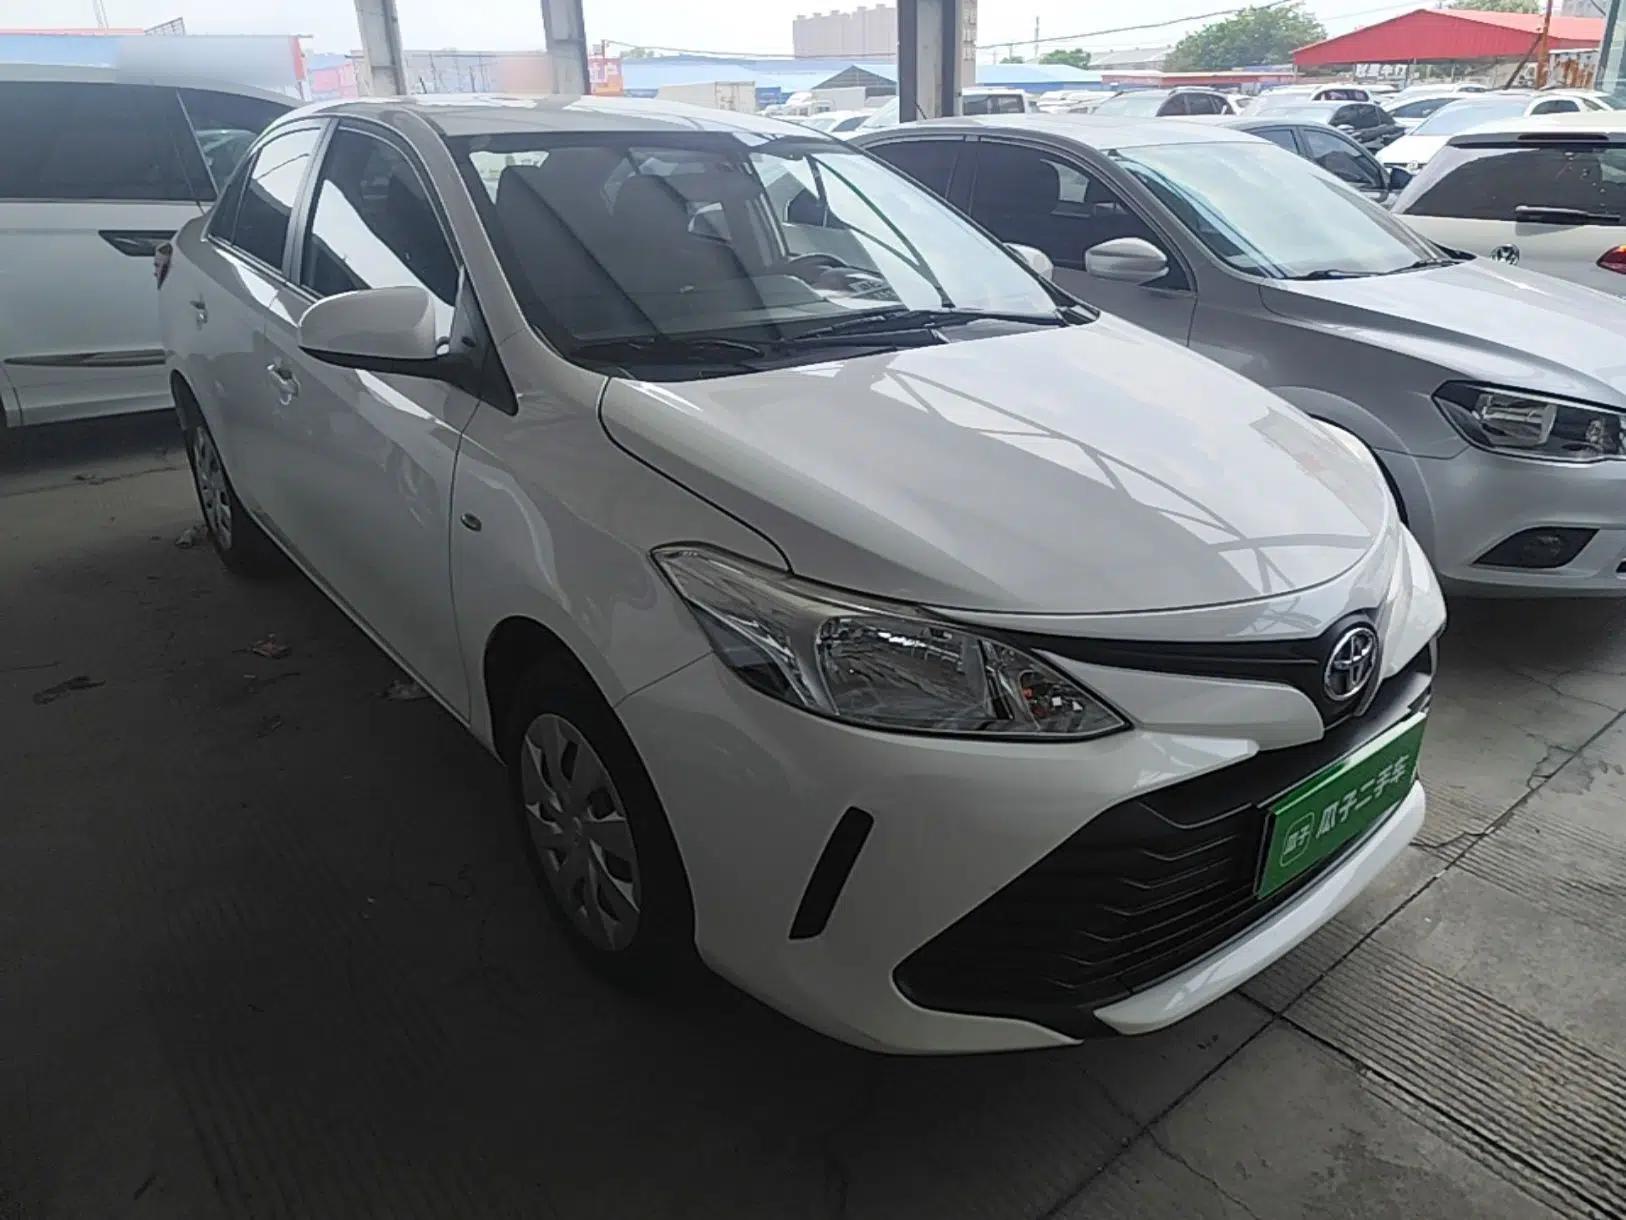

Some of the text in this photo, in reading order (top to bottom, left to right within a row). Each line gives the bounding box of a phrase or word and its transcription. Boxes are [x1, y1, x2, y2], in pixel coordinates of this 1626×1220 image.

[1315, 754, 1410, 840] 瓜子二手车
